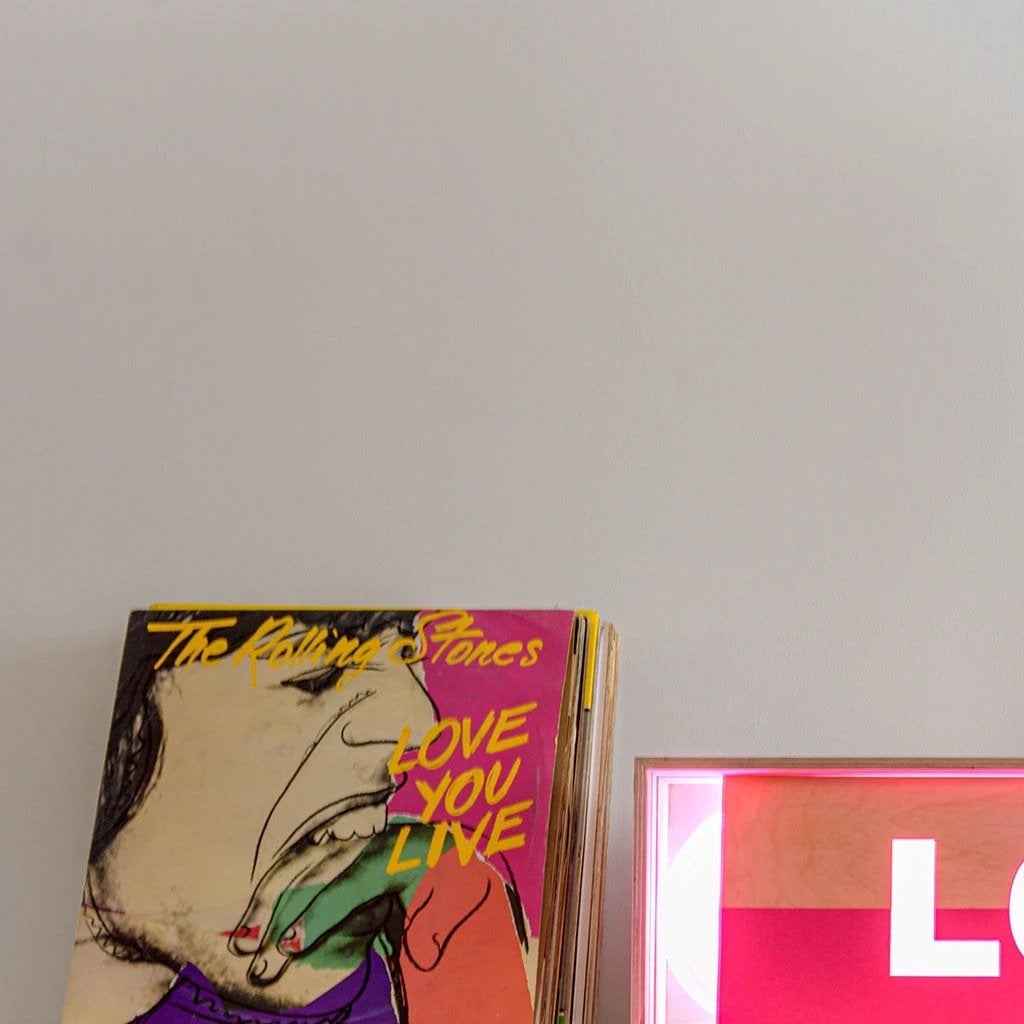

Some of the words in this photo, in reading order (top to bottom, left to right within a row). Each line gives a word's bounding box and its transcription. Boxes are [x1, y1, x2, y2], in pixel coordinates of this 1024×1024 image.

[146, 616, 237, 671] The
[232, 621, 381, 692] Rolling
[388, 610, 545, 669] Stones
[388, 702, 537, 775] LOVE
[414, 758, 520, 824] YOU
[385, 799, 534, 875] LIVE
